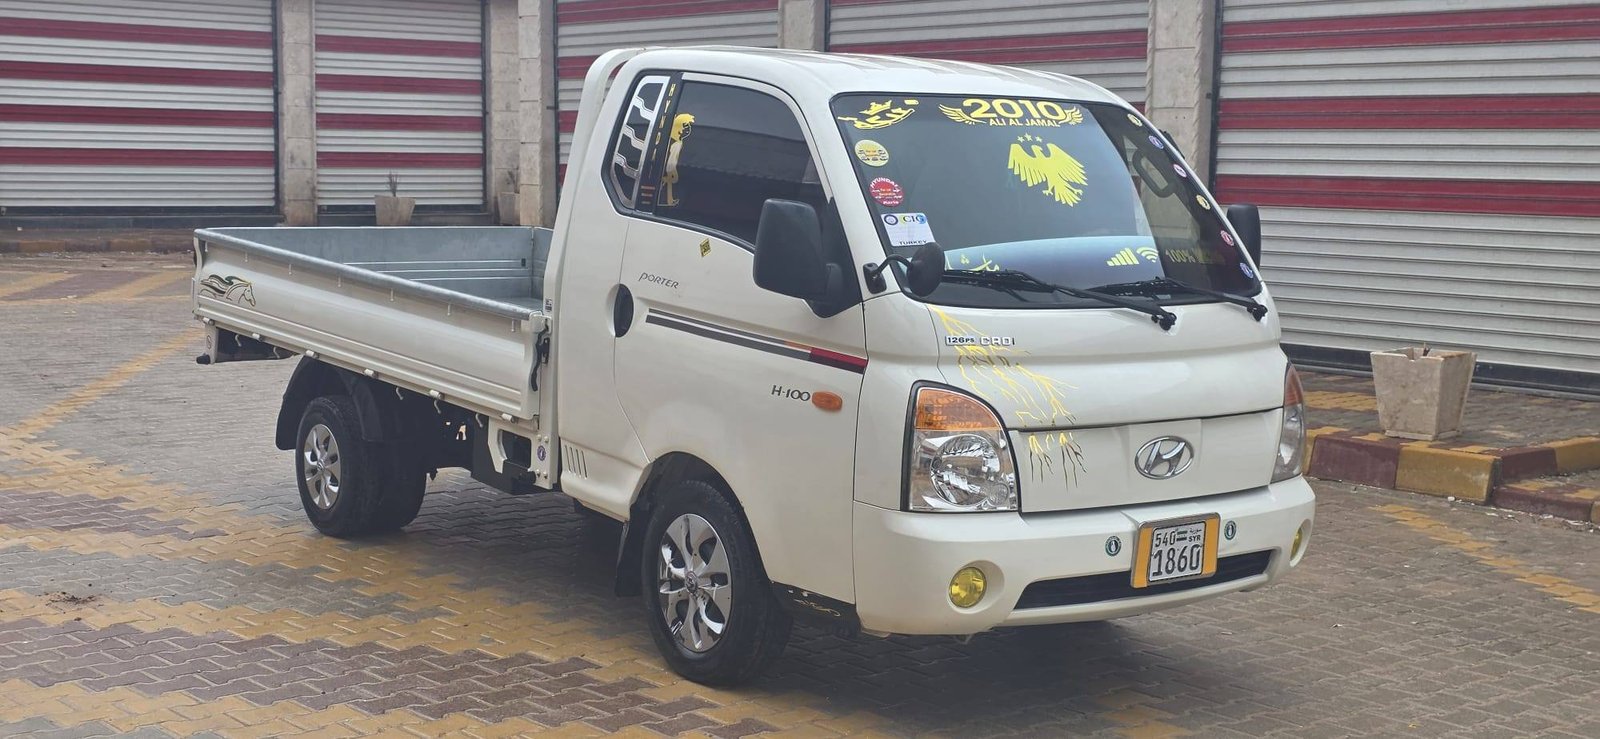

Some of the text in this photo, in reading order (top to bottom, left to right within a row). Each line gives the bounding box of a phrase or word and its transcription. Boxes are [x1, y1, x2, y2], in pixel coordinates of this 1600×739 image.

[962, 98, 1067, 120] 2010
[989, 118, 1007, 126] ALI
[1025, 119, 1061, 127] JAMAL
[1165, 249, 1196, 263] 100%
[638, 272, 680, 290] PORTER
[771, 384, 811, 402] H-100
[1155, 531, 1176, 547] 540
[1189, 535, 1201, 543] SYR
[1152, 544, 1203, 575] 1860
